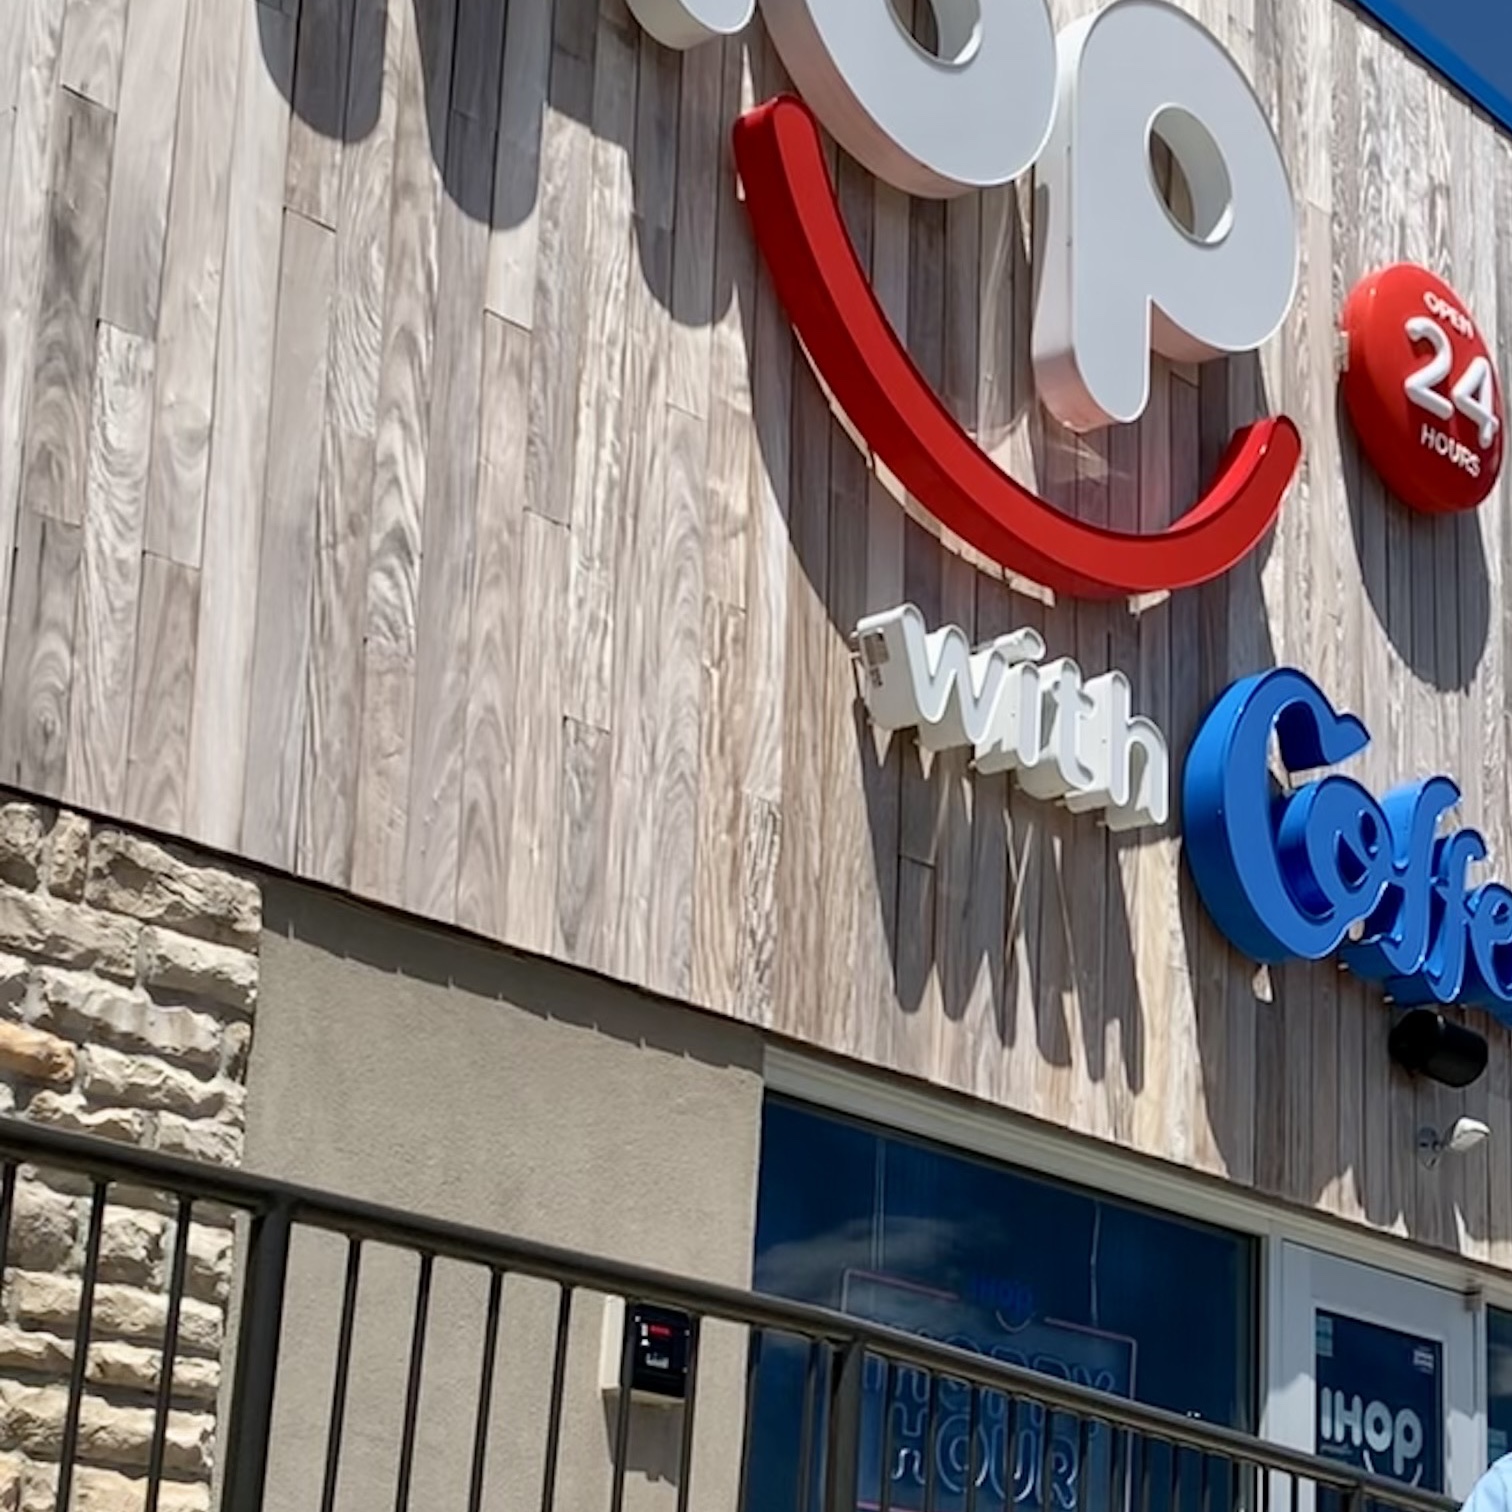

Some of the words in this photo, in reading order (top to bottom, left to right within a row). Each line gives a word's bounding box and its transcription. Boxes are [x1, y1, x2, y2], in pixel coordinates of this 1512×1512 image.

[1423, 291, 1474, 339] OPEN
[1404, 316, 1499, 448] 24
[1420, 423, 1481, 478] HOURS
[857, 604, 1168, 831] with
[1321, 1387, 1423, 1476] IHOP
